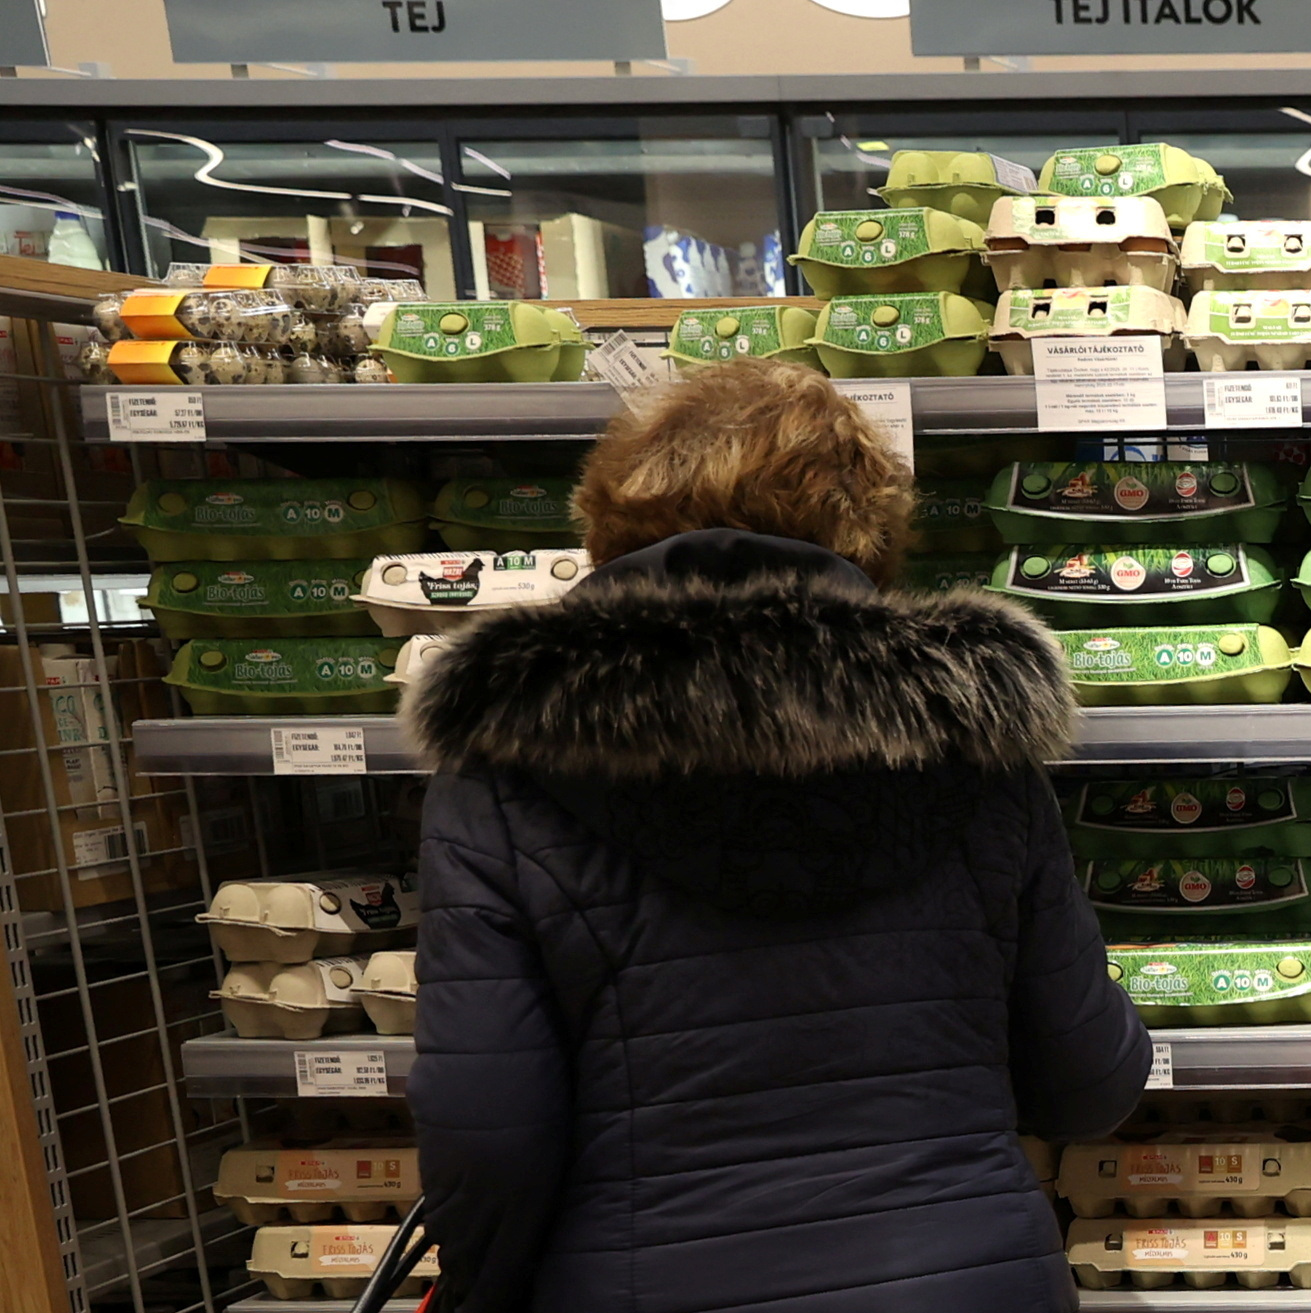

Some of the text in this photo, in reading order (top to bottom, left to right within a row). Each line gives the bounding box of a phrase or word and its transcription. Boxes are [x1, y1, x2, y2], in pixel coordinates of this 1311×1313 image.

[382, 1, 446, 33] TEJ
[860, 331, 867, 339] A
[428, 338, 437, 347] A
[470, 338, 476, 346] L
[497, 557, 533, 566] A 10 M
[428, 581, 451, 590] Friss
[294, 588, 304, 597] A
[312, 588, 325, 596] 10
[1074, 650, 1131, 668] Bio-tojás
[1161, 653, 1170, 662] A
[1178, 652, 1190, 661] 10
[1200, 652, 1211, 660] M
[322, 666, 332, 675] A
[339, 666, 353, 674] 10
[1237, 1232, 1243, 1241] S
[1136, 1238, 1159, 1249] FRISS
